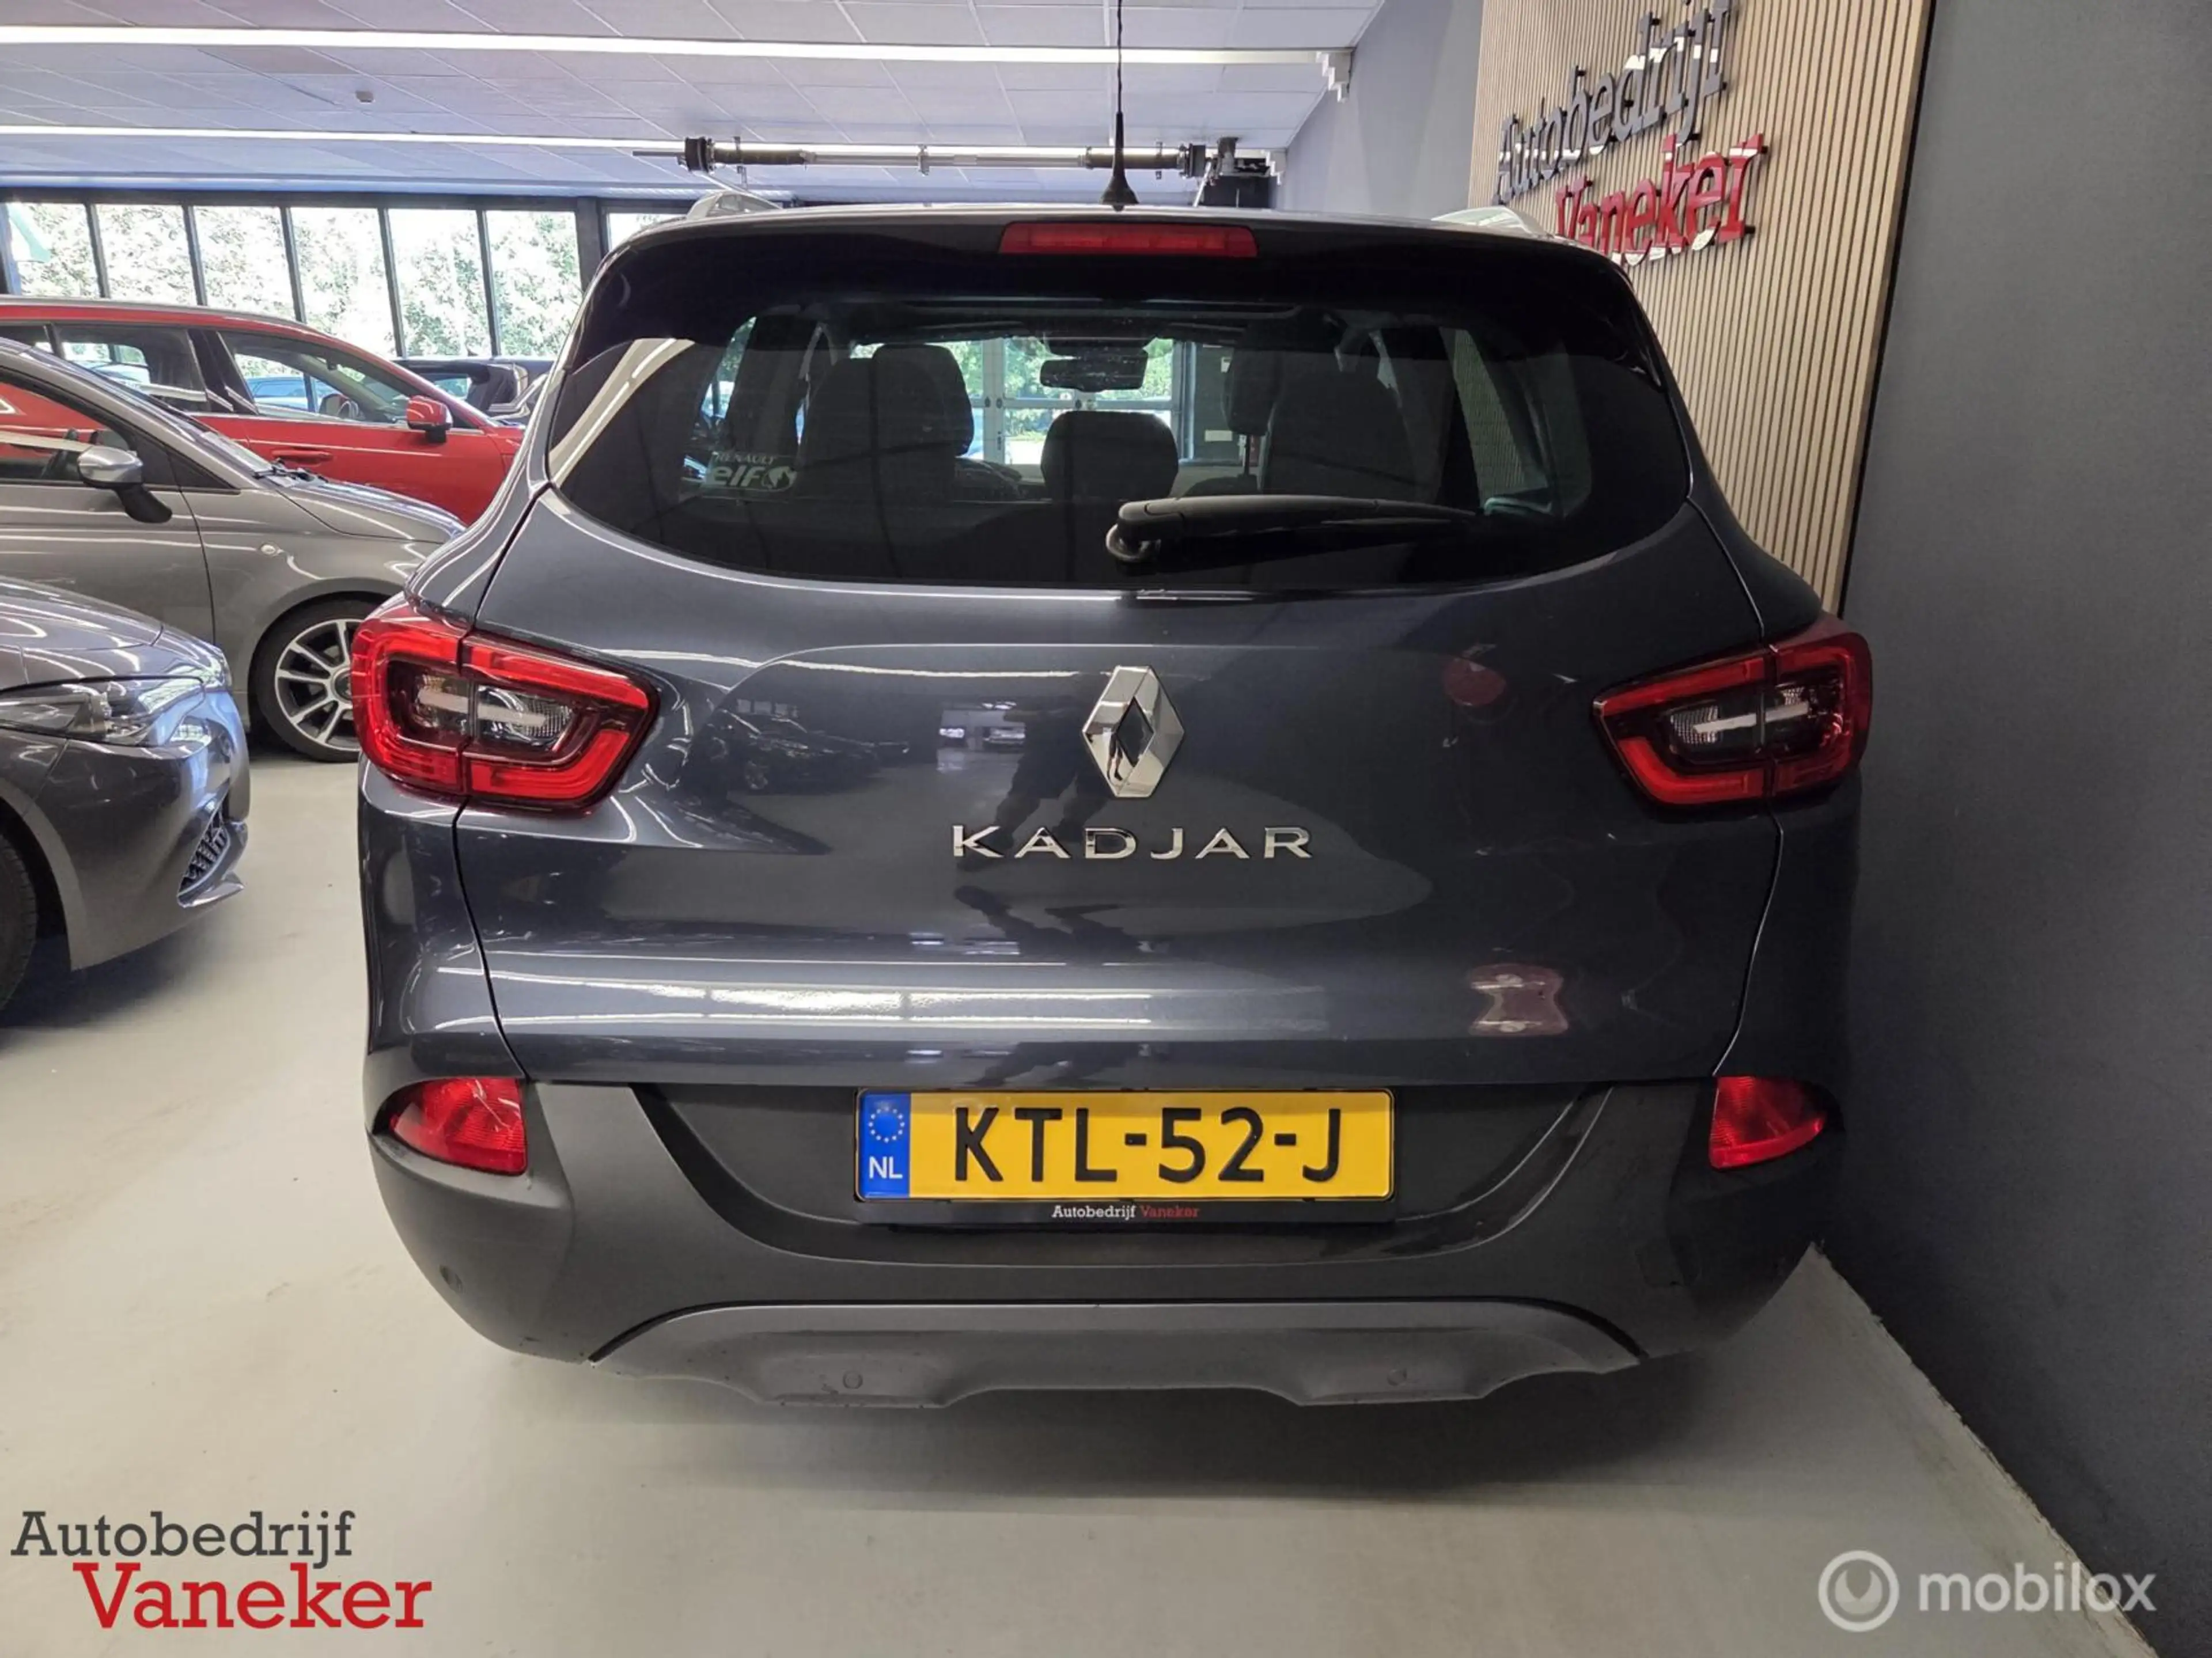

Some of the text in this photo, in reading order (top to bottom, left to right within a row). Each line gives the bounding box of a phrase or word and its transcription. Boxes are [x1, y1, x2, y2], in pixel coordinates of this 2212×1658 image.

[1491, 0, 1730, 205] Autobedrijf
[1555, 134, 1764, 266] Vaneker
[715, 452, 775, 465] RENAULT
[712, 465, 766, 487] elf
[952, 824, 1313, 860] KADJAR
[954, 1107, 1342, 1183] KTL-52-J
[869, 1156, 903, 1179] NL
[1052, 1205, 1200, 1220] Autobedrijf Vaneker
